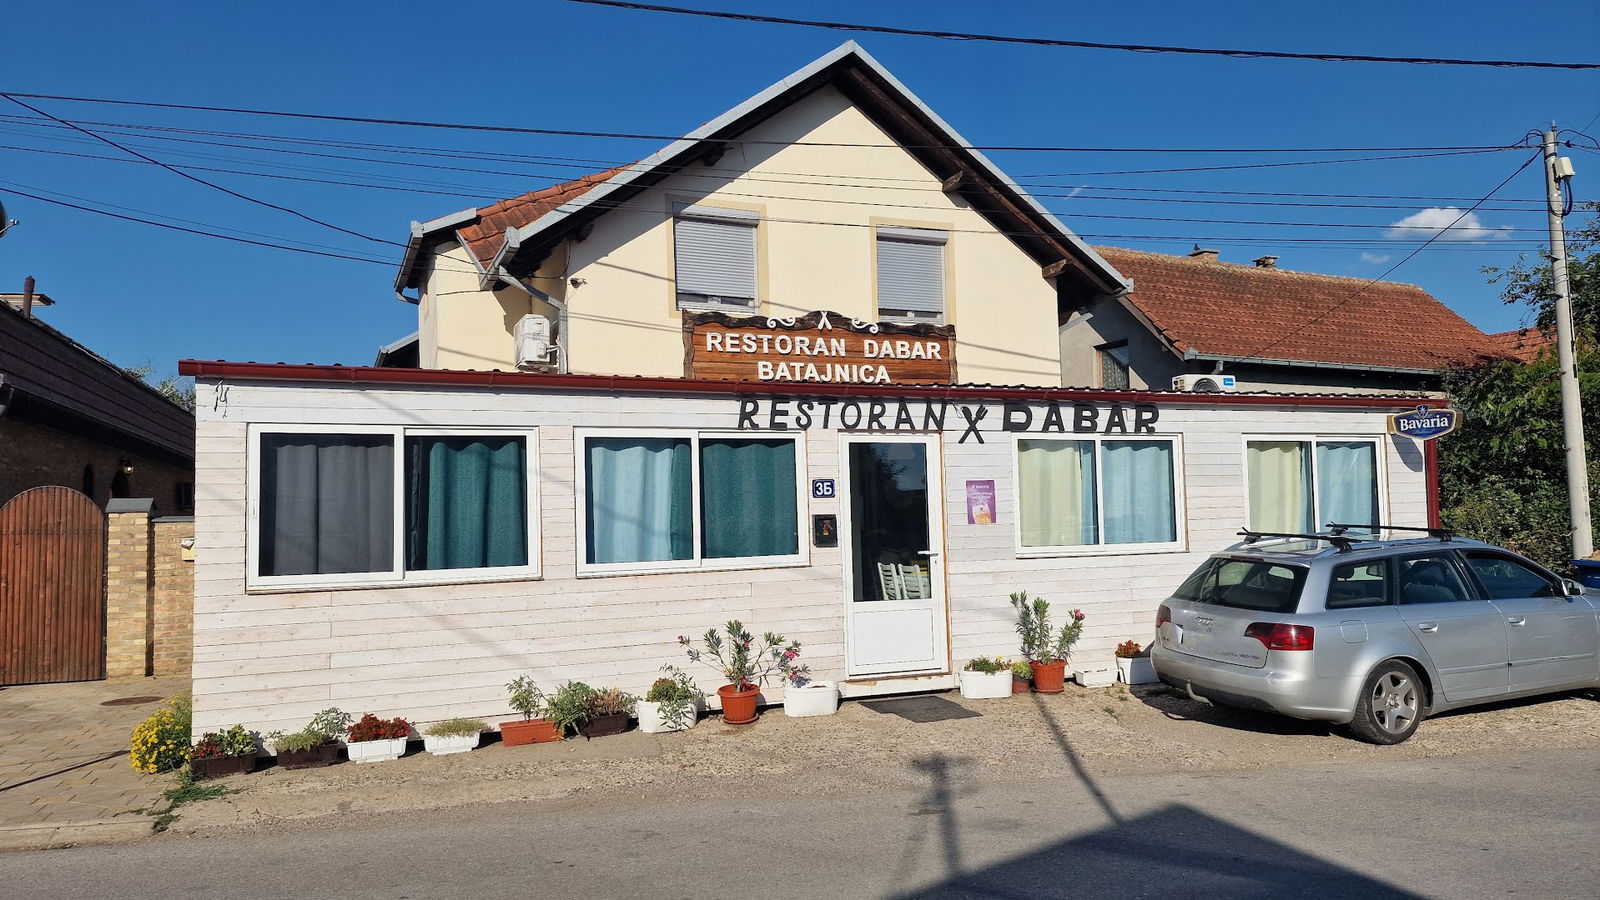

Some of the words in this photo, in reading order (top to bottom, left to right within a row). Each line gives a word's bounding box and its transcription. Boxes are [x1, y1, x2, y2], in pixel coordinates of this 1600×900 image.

[706, 332, 846, 357] RESTORAN
[863, 339, 942, 360] DABAR
[757, 361, 891, 383] BATAJNICA
[738, 399, 948, 431] RESTORAN
[1002, 403, 1159, 434] DABAR
[1400, 415, 1449, 431] Bavaria
